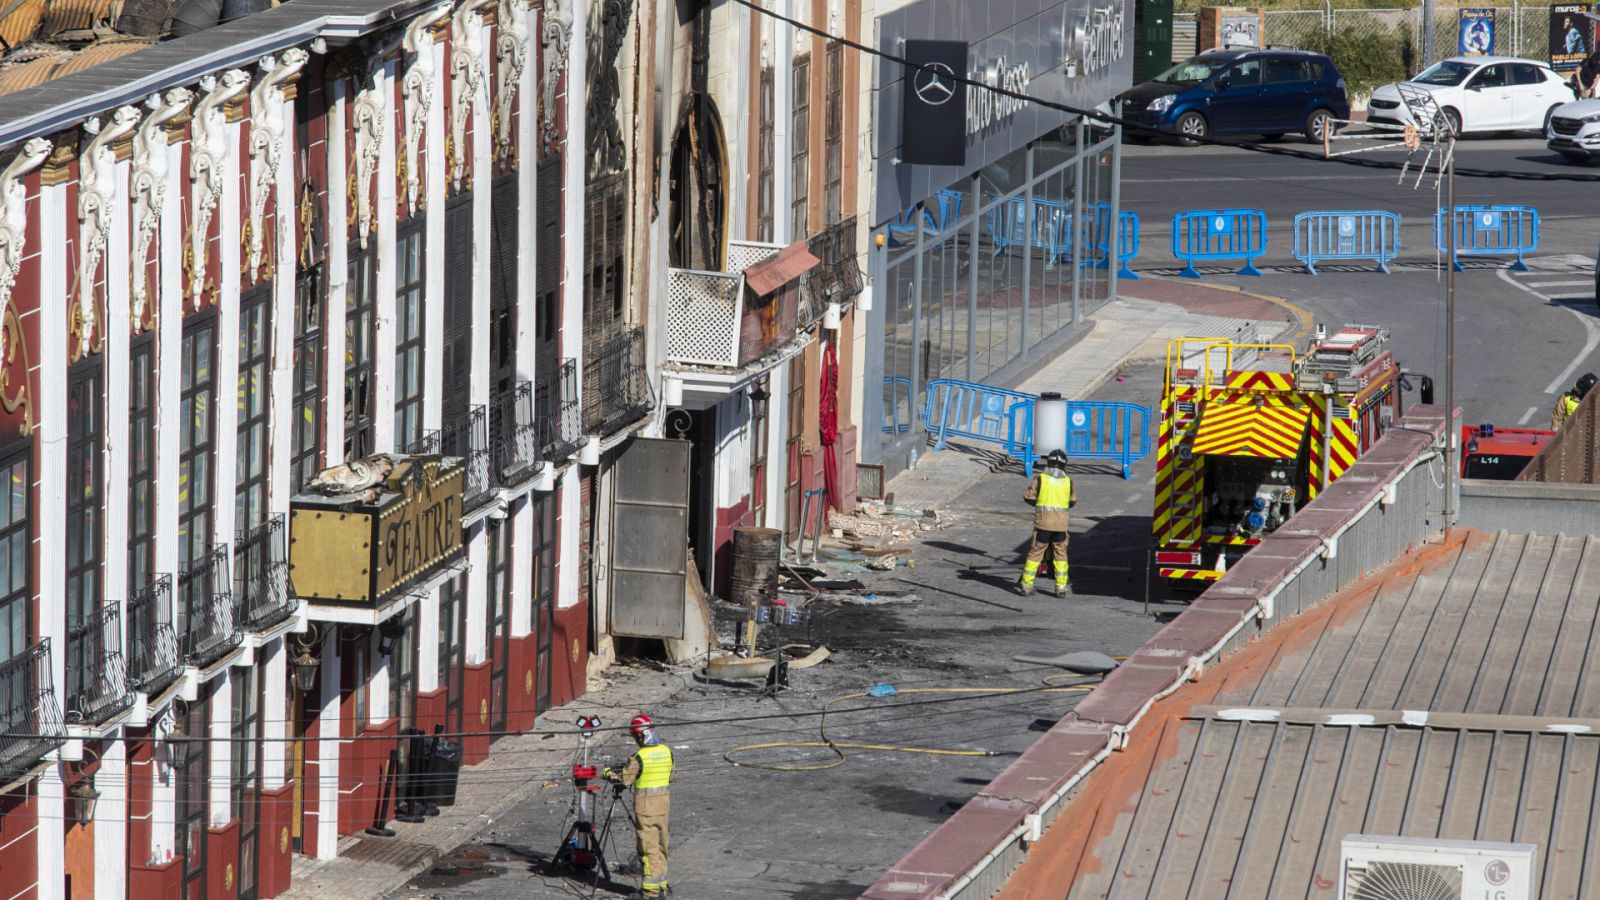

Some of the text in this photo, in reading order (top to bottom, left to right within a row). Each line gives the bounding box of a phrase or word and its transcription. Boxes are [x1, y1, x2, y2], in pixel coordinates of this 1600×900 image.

[966, 72, 992, 136] Auto
[1083, 0, 1124, 76] Certified
[1480, 456, 1499, 464] L14
[385, 494, 455, 583] TEATRE
